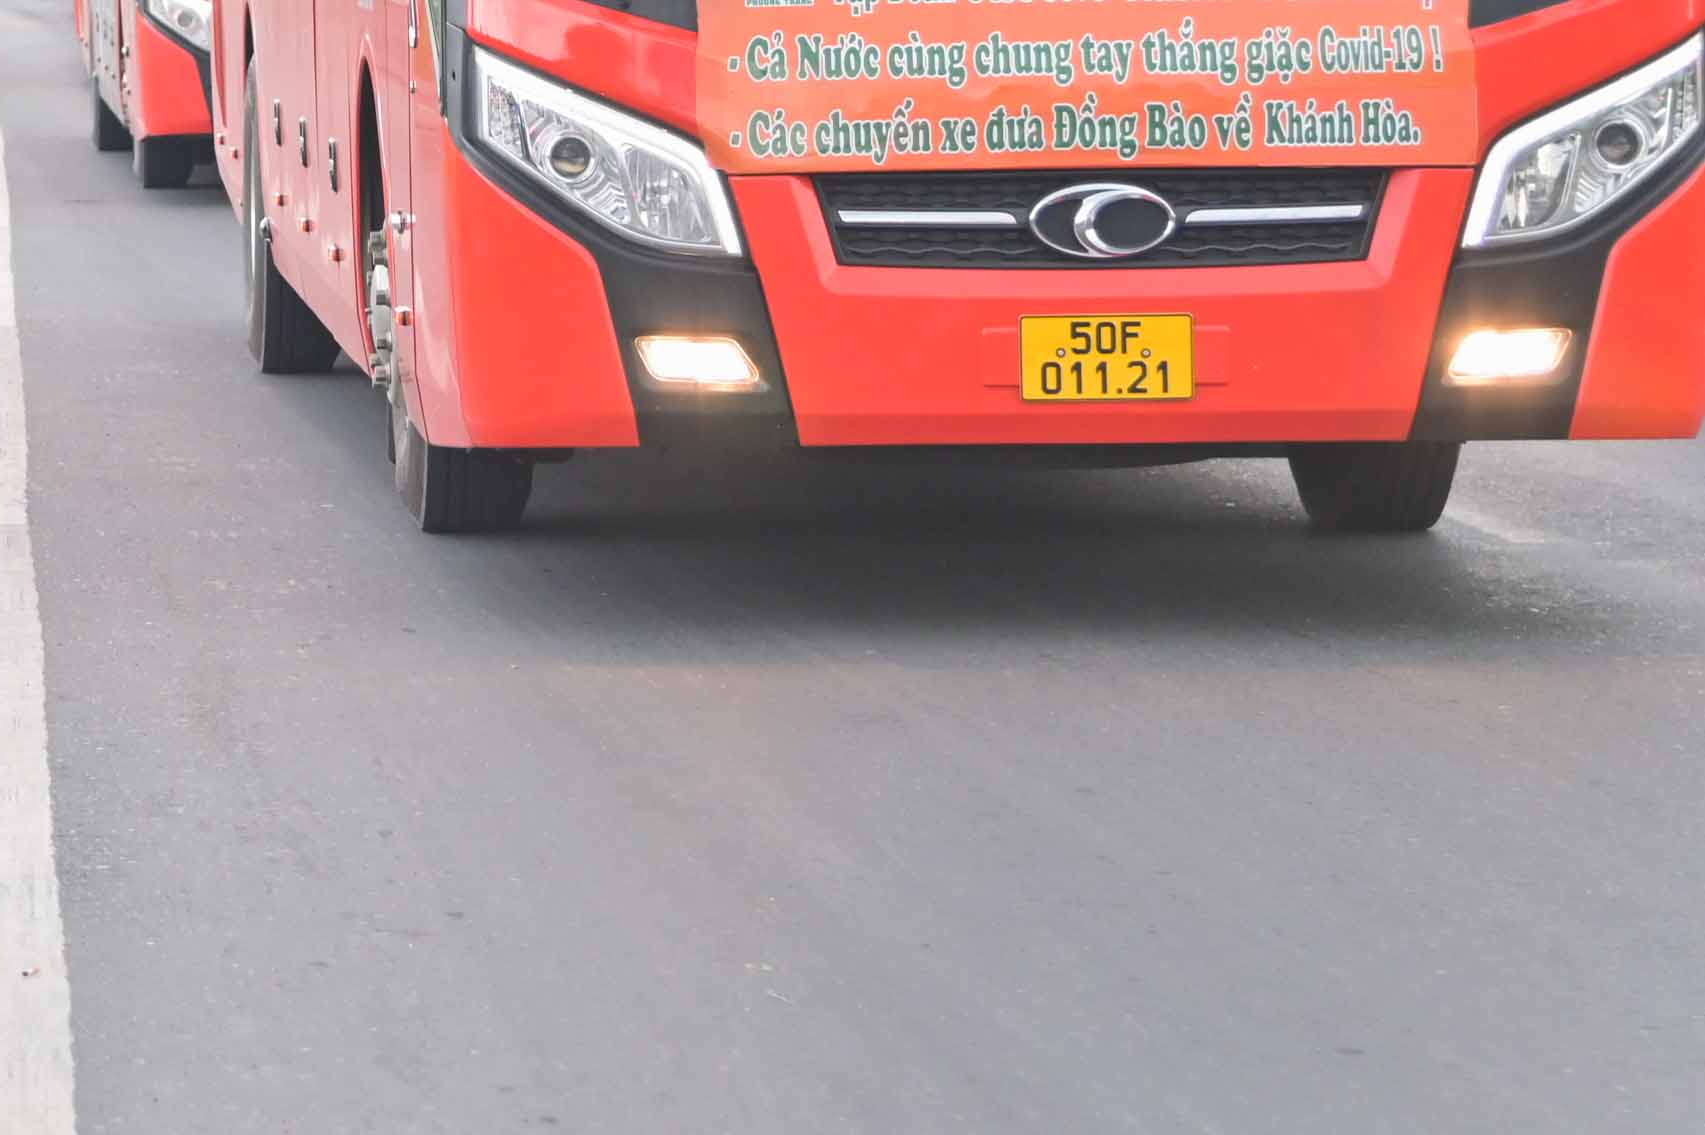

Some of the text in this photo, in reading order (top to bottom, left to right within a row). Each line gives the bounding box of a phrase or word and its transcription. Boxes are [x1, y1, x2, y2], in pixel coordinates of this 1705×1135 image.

[746, 30, 787, 81] Cả
[796, 32, 880, 80] Nước
[887, 31, 967, 87] cùng
[973, 31, 1074, 87] chung
[1079, 31, 1133, 82] tay
[1142, 17, 1238, 85] thắng
[1245, 25, 1312, 84] giặc
[1319, 25, 1424, 74] Covid-19
[747, 108, 807, 157] Các
[814, 98, 931, 164] chuyến
[939, 118, 977, 154] xe
[984, 104, 1044, 152] đưa
[1052, 92, 1137, 160] Đồng
[1146, 102, 1206, 150] Bào
[1213, 91, 1252, 150] về
[1264, 99, 1356, 147] Khánh
[1360, 99, 1421, 145] Hòa.
[1069, 321, 1142, 355] 50F
[1040, 360, 1169, 395] 011.21
